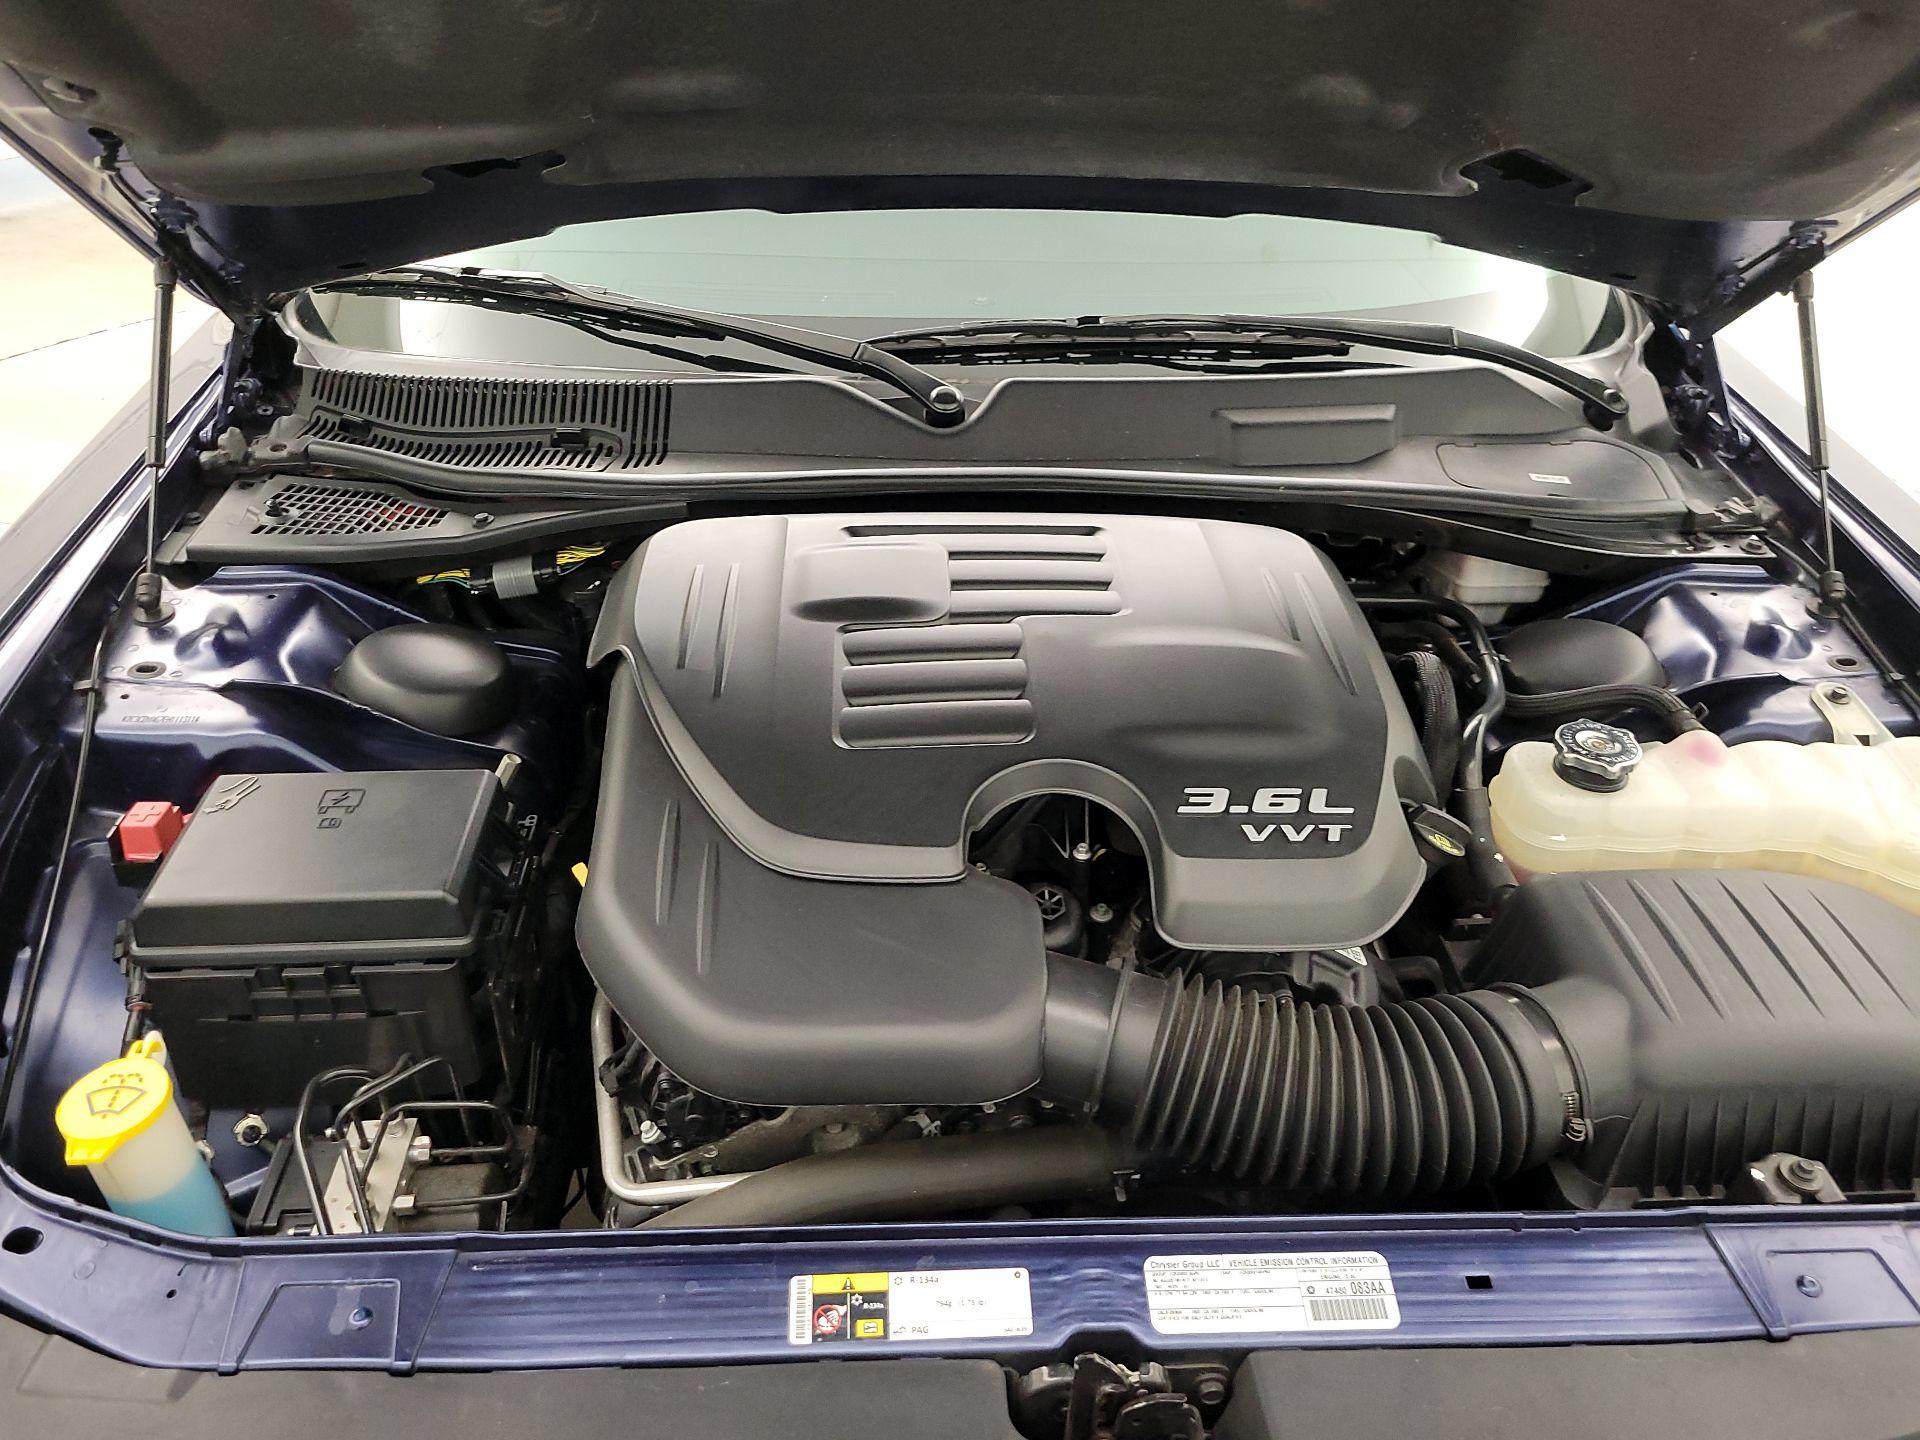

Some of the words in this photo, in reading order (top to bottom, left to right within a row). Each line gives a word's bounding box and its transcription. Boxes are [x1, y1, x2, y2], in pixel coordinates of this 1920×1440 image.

[1177, 787, 1355, 815] 3.6L
[1240, 823, 1353, 843] VVT
[1150, 1261, 1180, 1270] Chrysler
[1182, 1260, 1204, 1269] Group
[1206, 1259, 1220, 1268] LLC
[1228, 1258, 1257, 1267] VEHICLE
[1260, 1258, 1293, 1267] EMISSION
[1295, 1257, 1328, 1266] CONTROL
[1330, 1256, 1379, 1265] INFORMATION
[909, 1276, 939, 1284] R-134a
[911, 1326, 929, 1334] PAG
